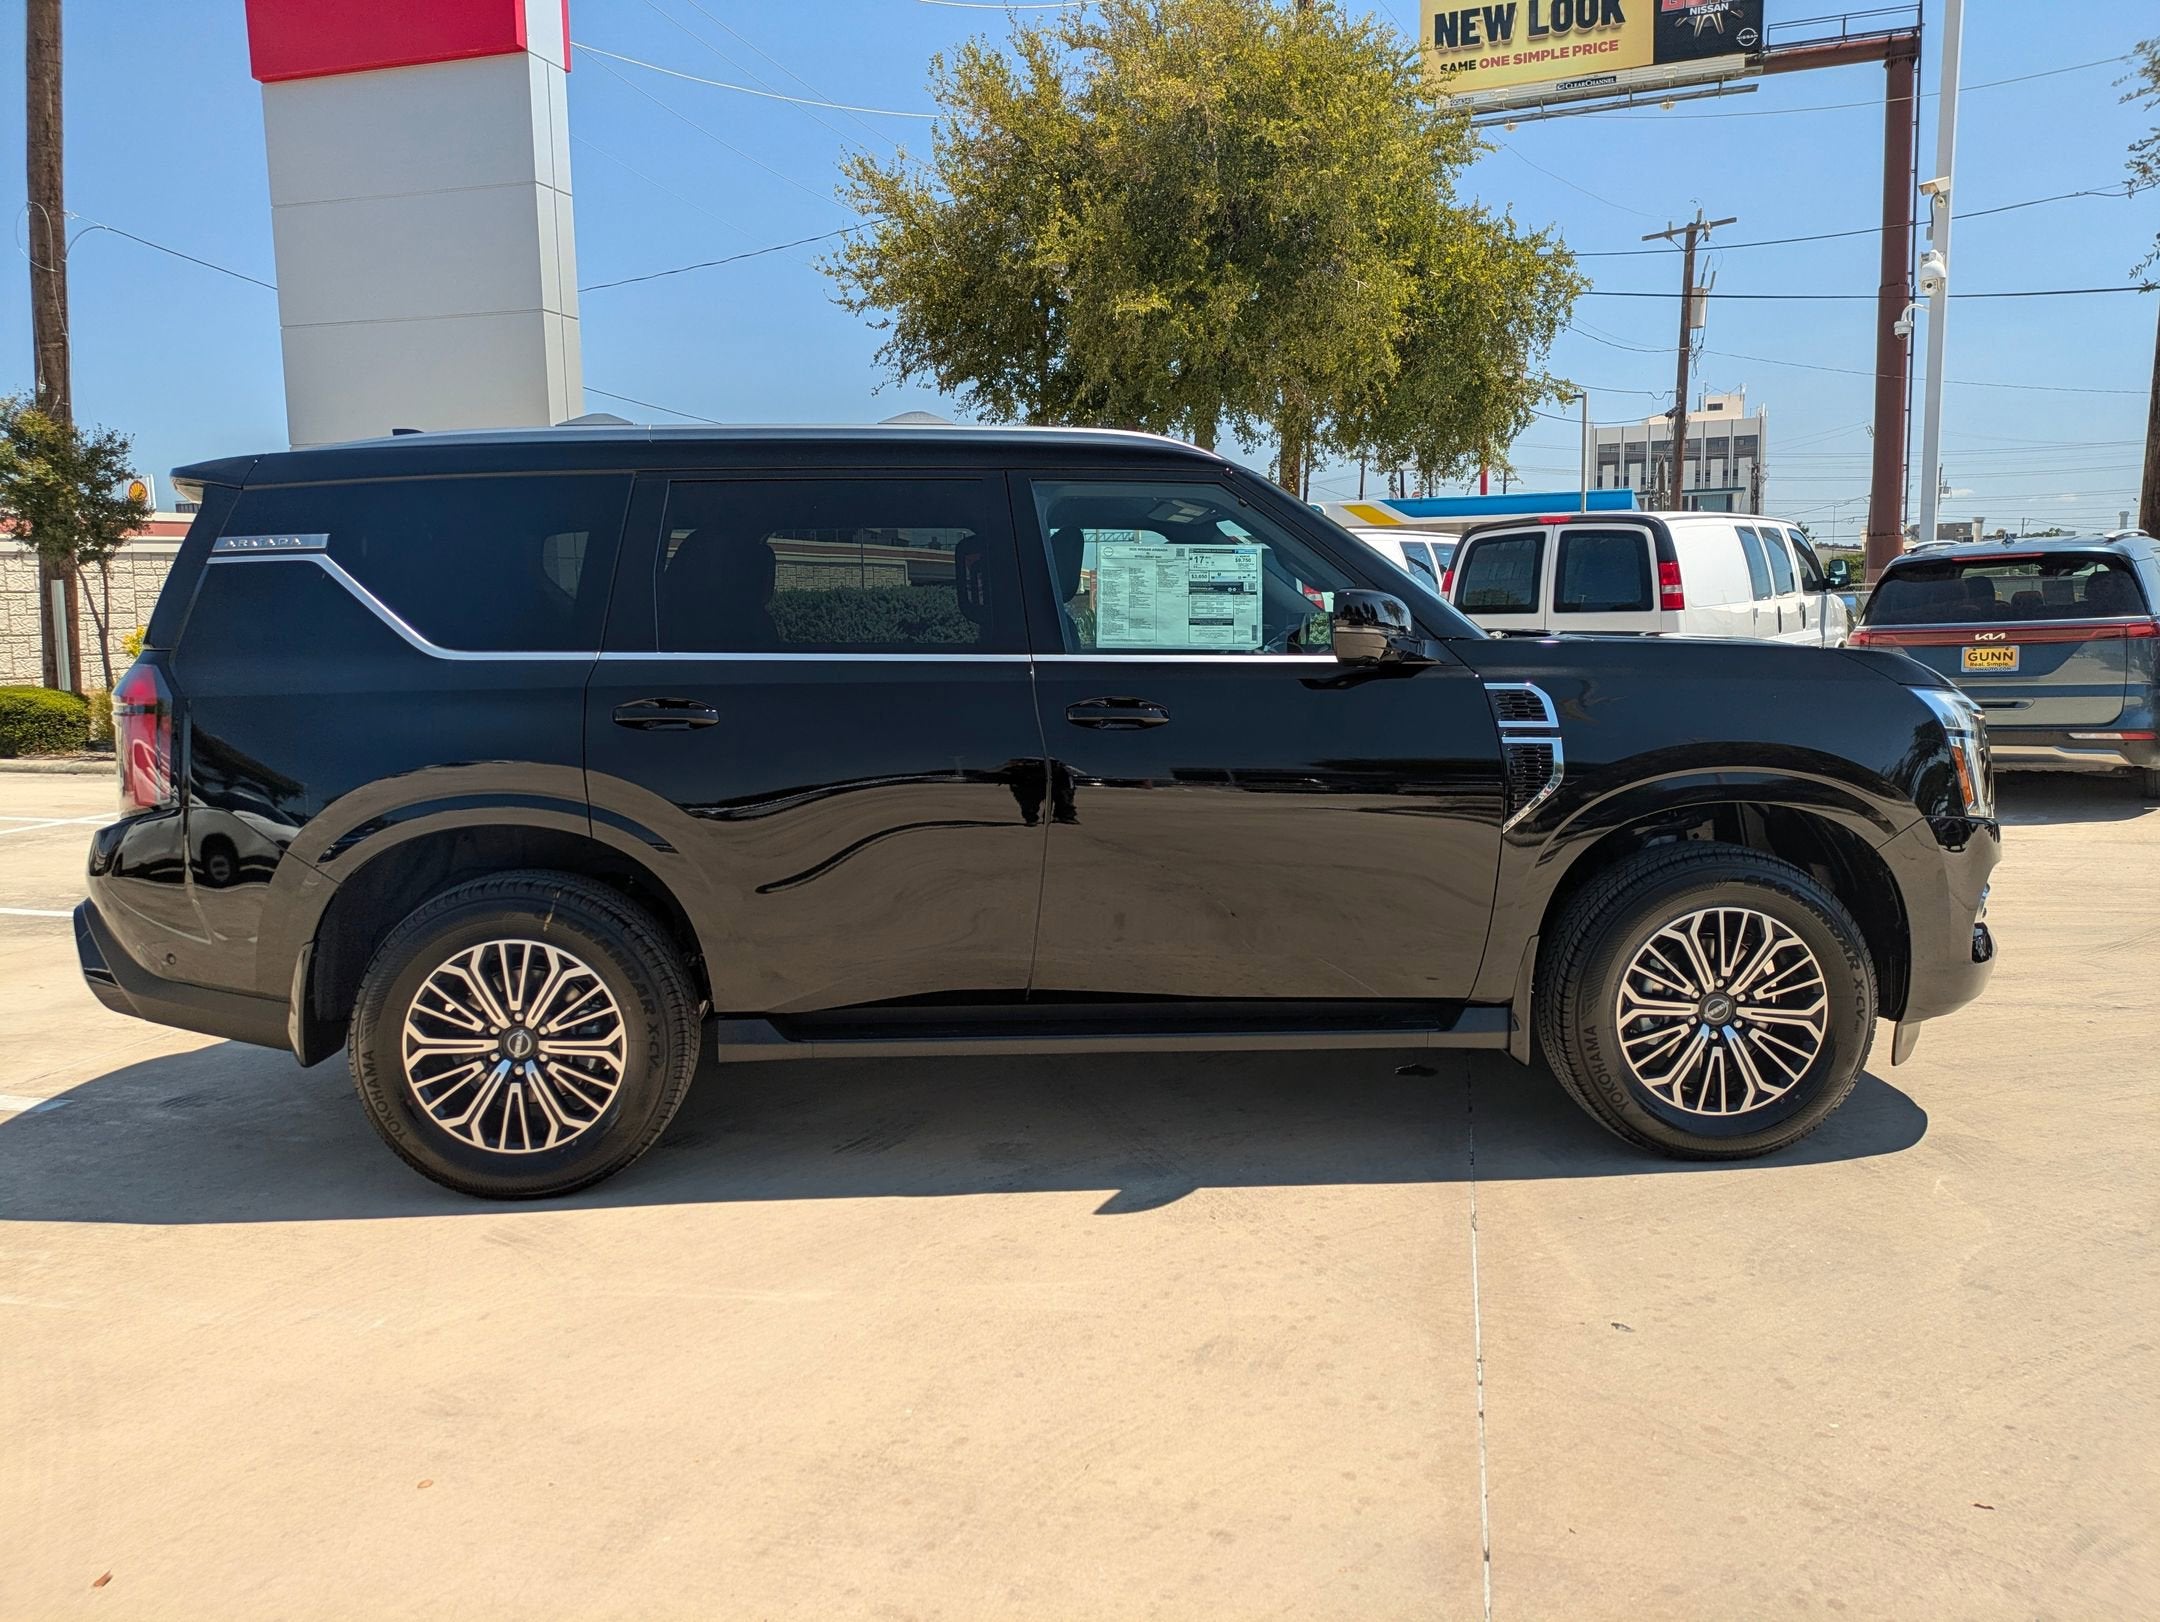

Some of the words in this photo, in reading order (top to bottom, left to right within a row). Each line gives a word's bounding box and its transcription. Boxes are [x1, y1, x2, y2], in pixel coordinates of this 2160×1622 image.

[1433, 2, 1517, 50] NEW
[1689, 3, 1729, 16] NISSAN
[1440, 59, 1477, 75] SAME
[1479, 55, 1510, 70] ONE
[1513, 47, 1569, 65] SIMPLE
[1572, 39, 1619, 57] PRICE
[1975, 632, 2006, 640] KIA
[1968, 651, 2013, 661] GUNN
[1583, 1024, 1630, 1112] YOKOHAMA
[362, 1050, 407, 1140] YOKOHAMA
